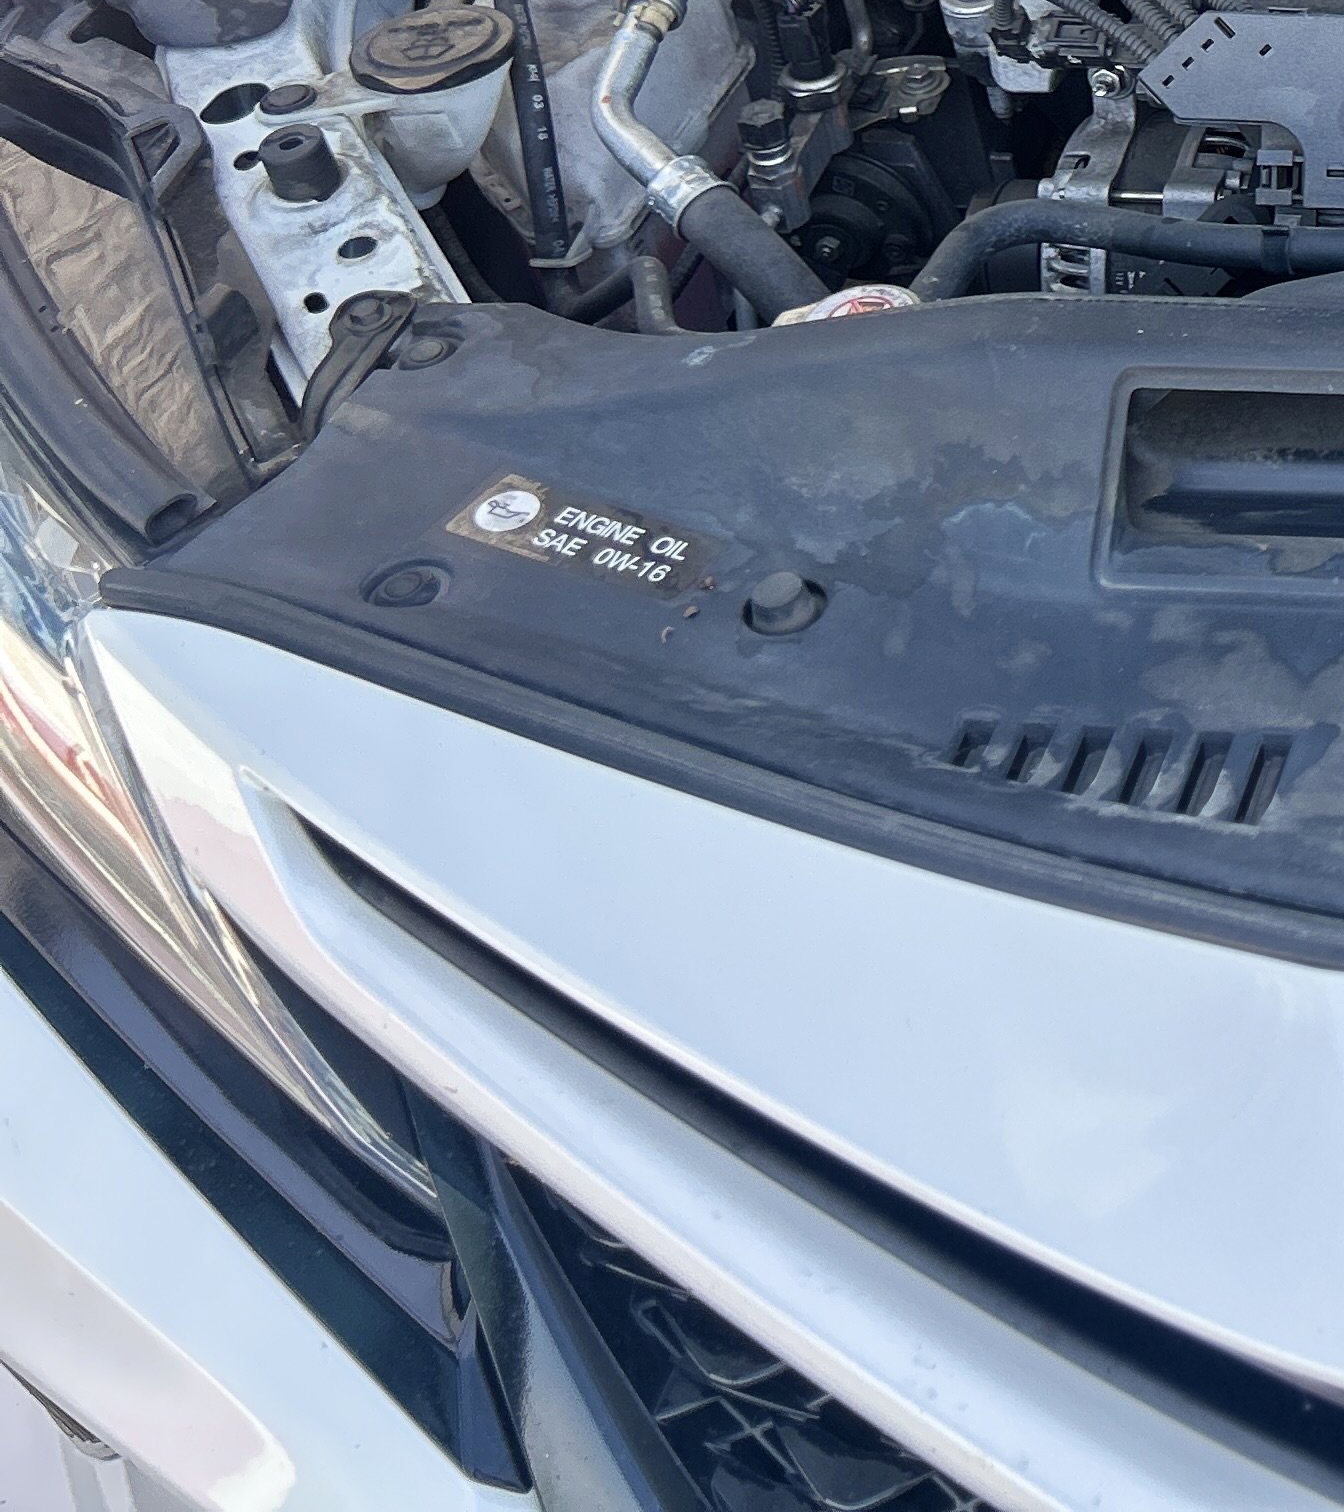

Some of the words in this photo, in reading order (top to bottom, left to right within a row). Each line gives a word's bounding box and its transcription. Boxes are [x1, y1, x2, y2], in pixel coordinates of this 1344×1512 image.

[532, 528, 588, 556] SAE
[592, 548, 672, 583] 0W-16
[553, 506, 646, 546] ENGINE
[650, 536, 689, 561] OIL
